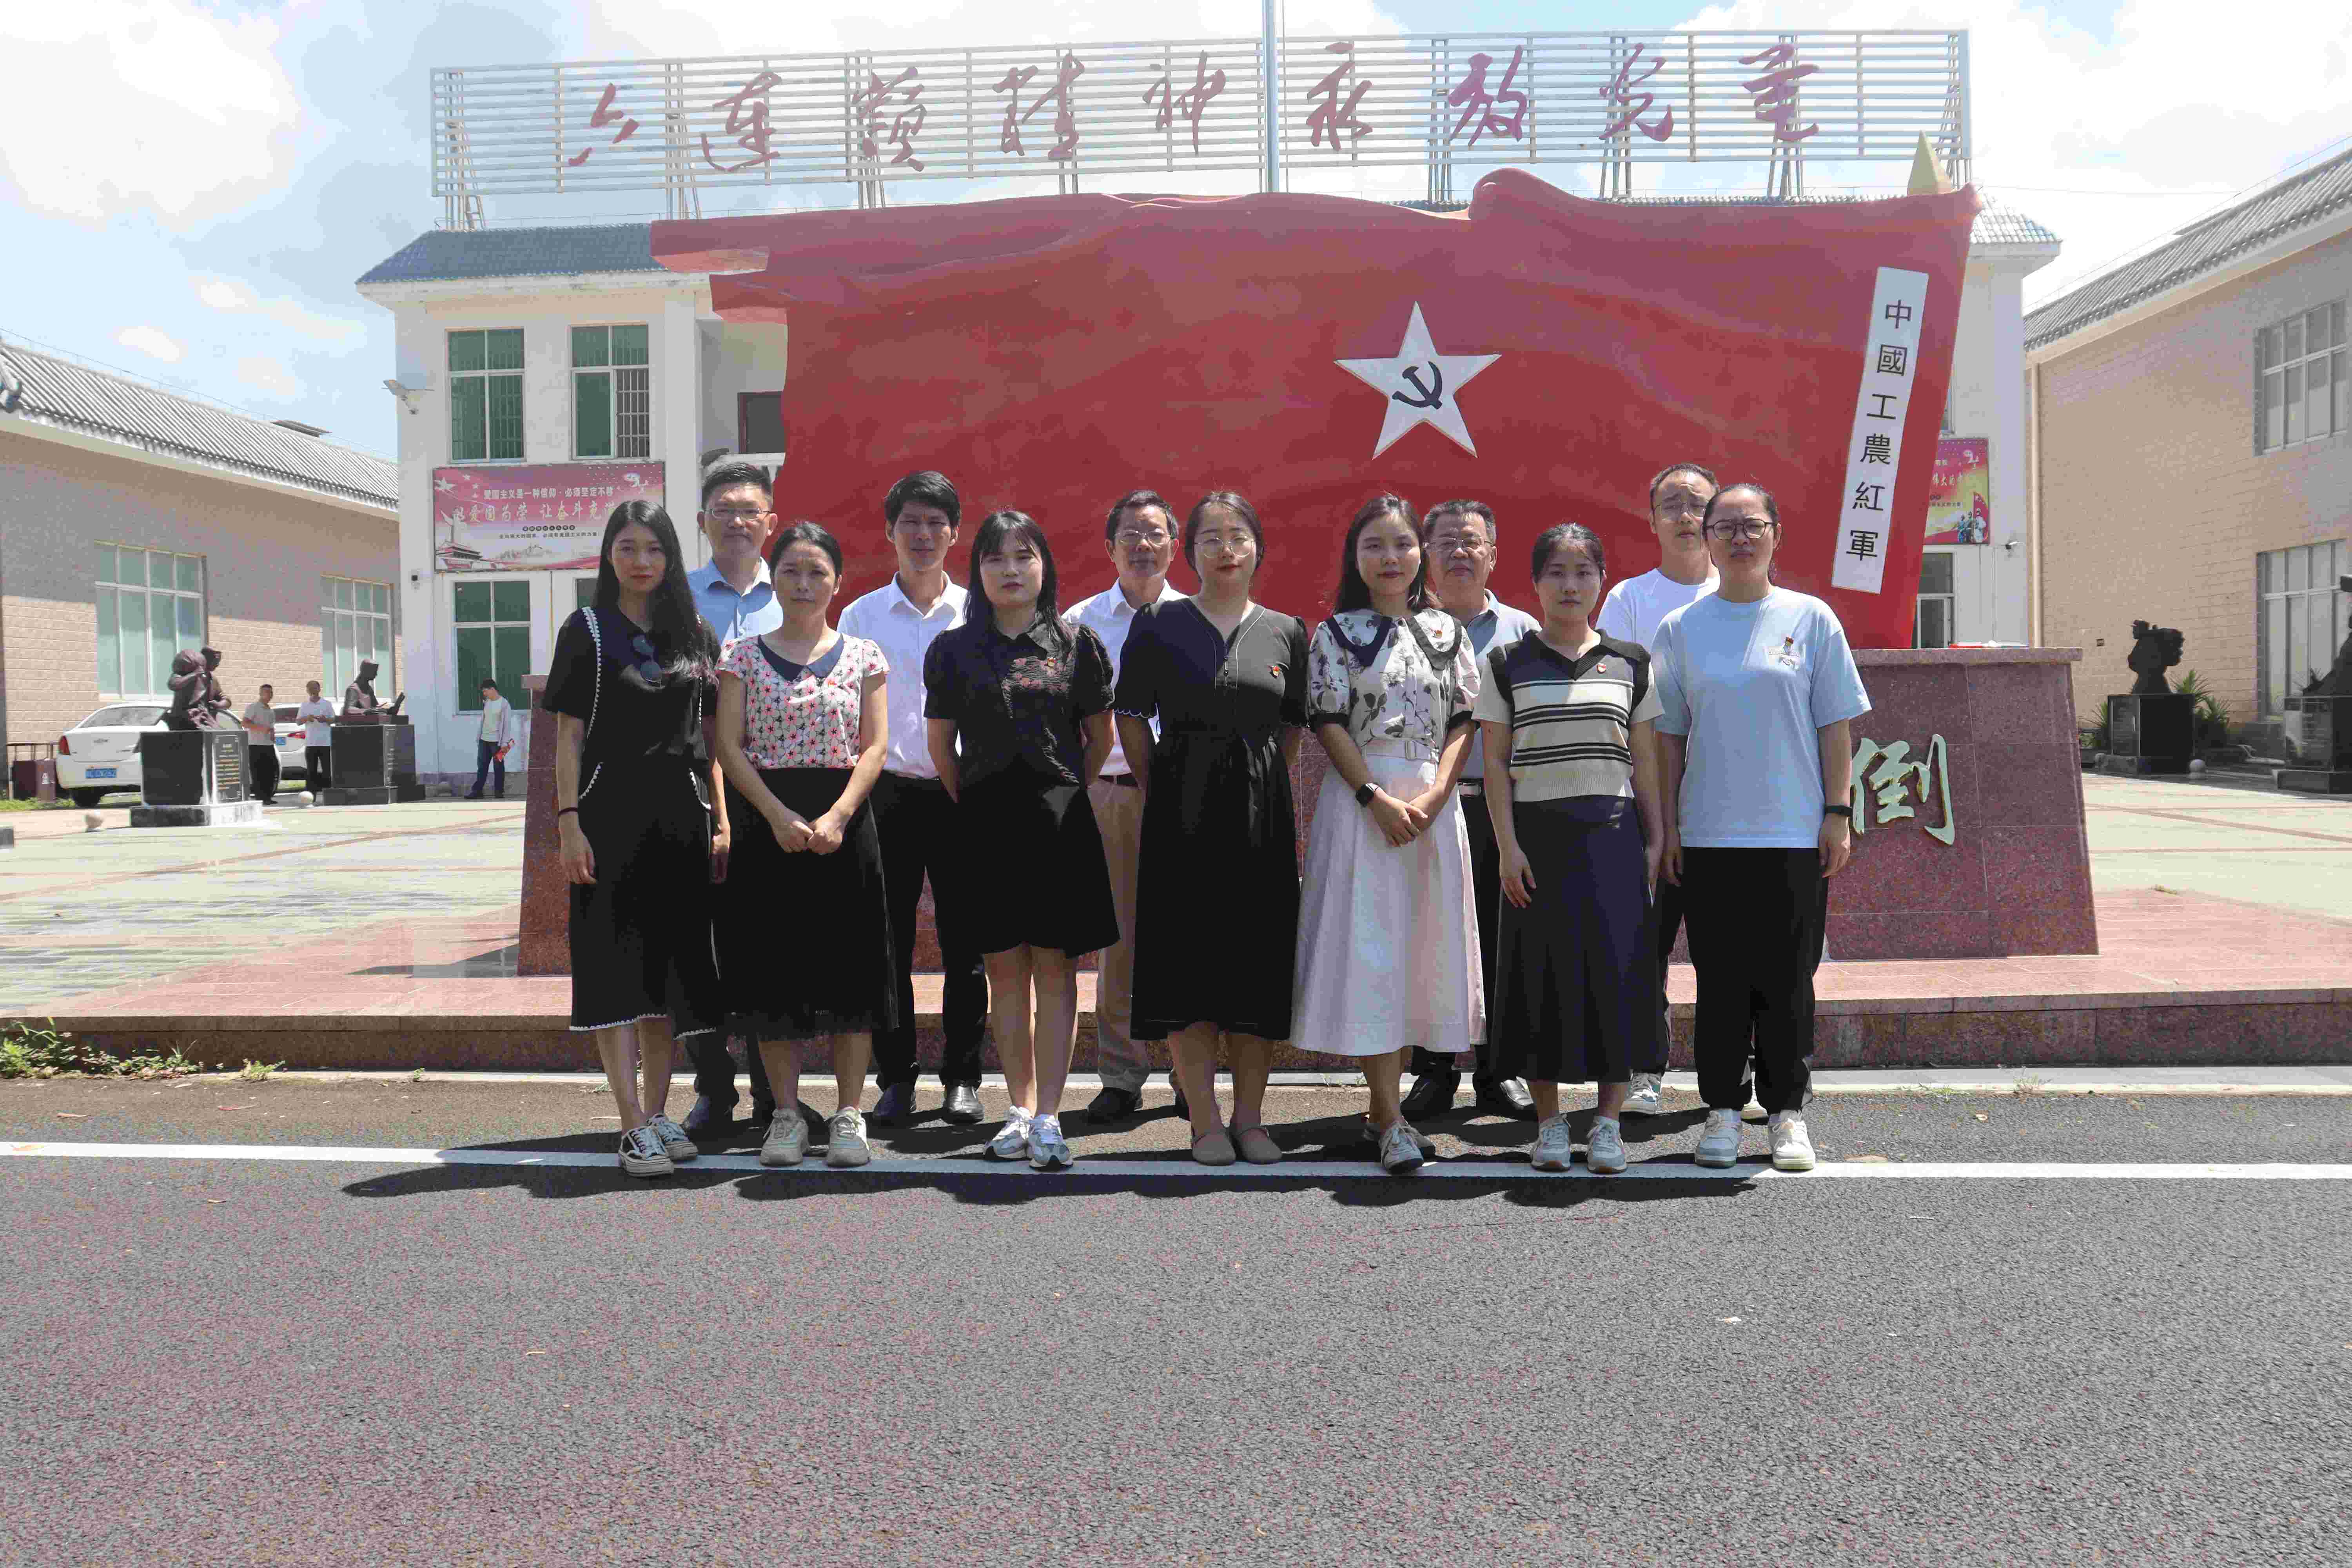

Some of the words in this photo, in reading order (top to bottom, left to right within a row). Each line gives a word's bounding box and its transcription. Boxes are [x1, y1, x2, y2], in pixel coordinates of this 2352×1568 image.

[1846, 299, 1912, 561] 中國工農紅軍
[1849, 734, 1955, 845] 倒
